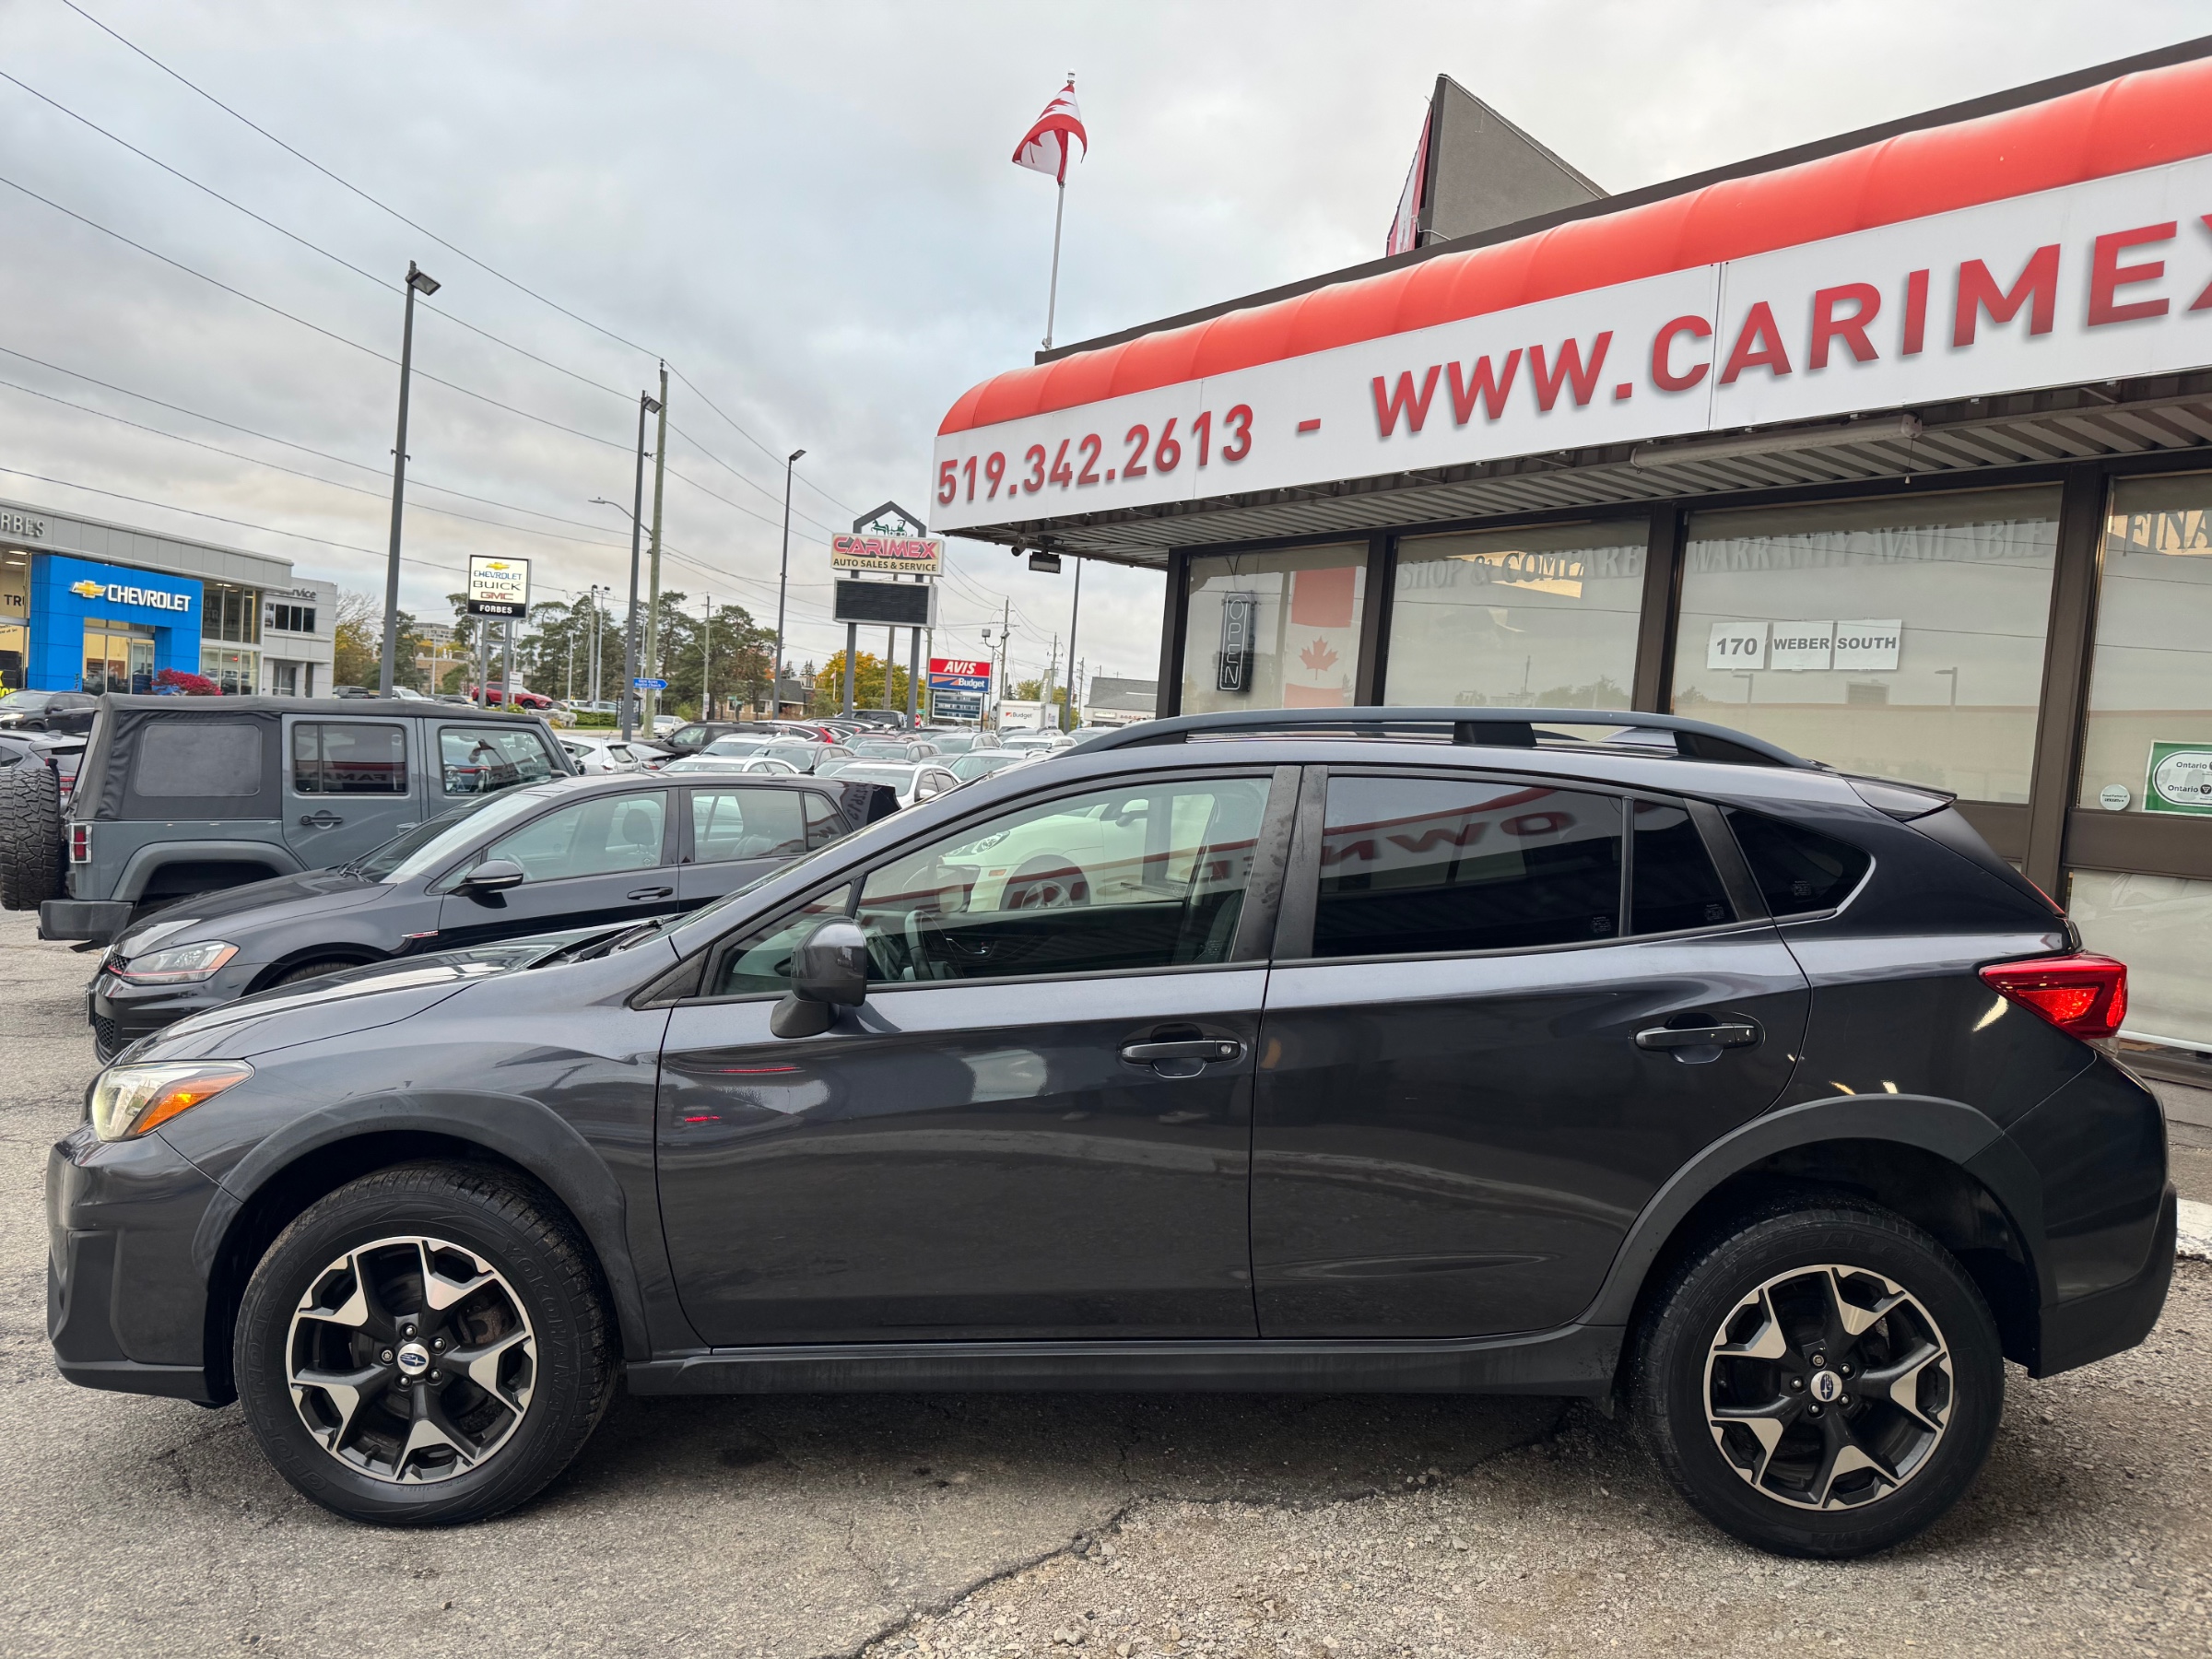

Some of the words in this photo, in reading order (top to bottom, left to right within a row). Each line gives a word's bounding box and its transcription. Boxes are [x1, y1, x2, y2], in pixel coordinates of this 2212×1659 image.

[937, 404, 1254, 505] 519.342.2613
[833, 536, 938, 559] CARIMEX
[833, 558, 859, 567] AUTO
[860, 559, 888, 570] SALES
[890, 561, 898, 570] &
[899, 562, 936, 571] SERVICE
[1398, 559, 1465, 590] SHOP
[1500, 544, 1643, 583] COMPARE
[474, 571, 523, 581] CHEVROLET
[473, 581, 522, 591] BUICK
[107, 583, 192, 612] CHEVROLET
[480, 592, 514, 601] GMC
[479, 605, 513, 614] FORBES
[1224, 599, 1244, 685] OPEN
[1715, 637, 1758, 656] 170
[1773, 637, 1830, 651] WEBER
[1837, 636, 1898, 650] SOUTH
[943, 661, 977, 675] AVIS
[958, 677, 985, 688] Budget
[1013, 712, 1033, 720] Budget
[2176, 761, 2207, 770] Ontario
[2168, 784, 2199, 793] Ontario
